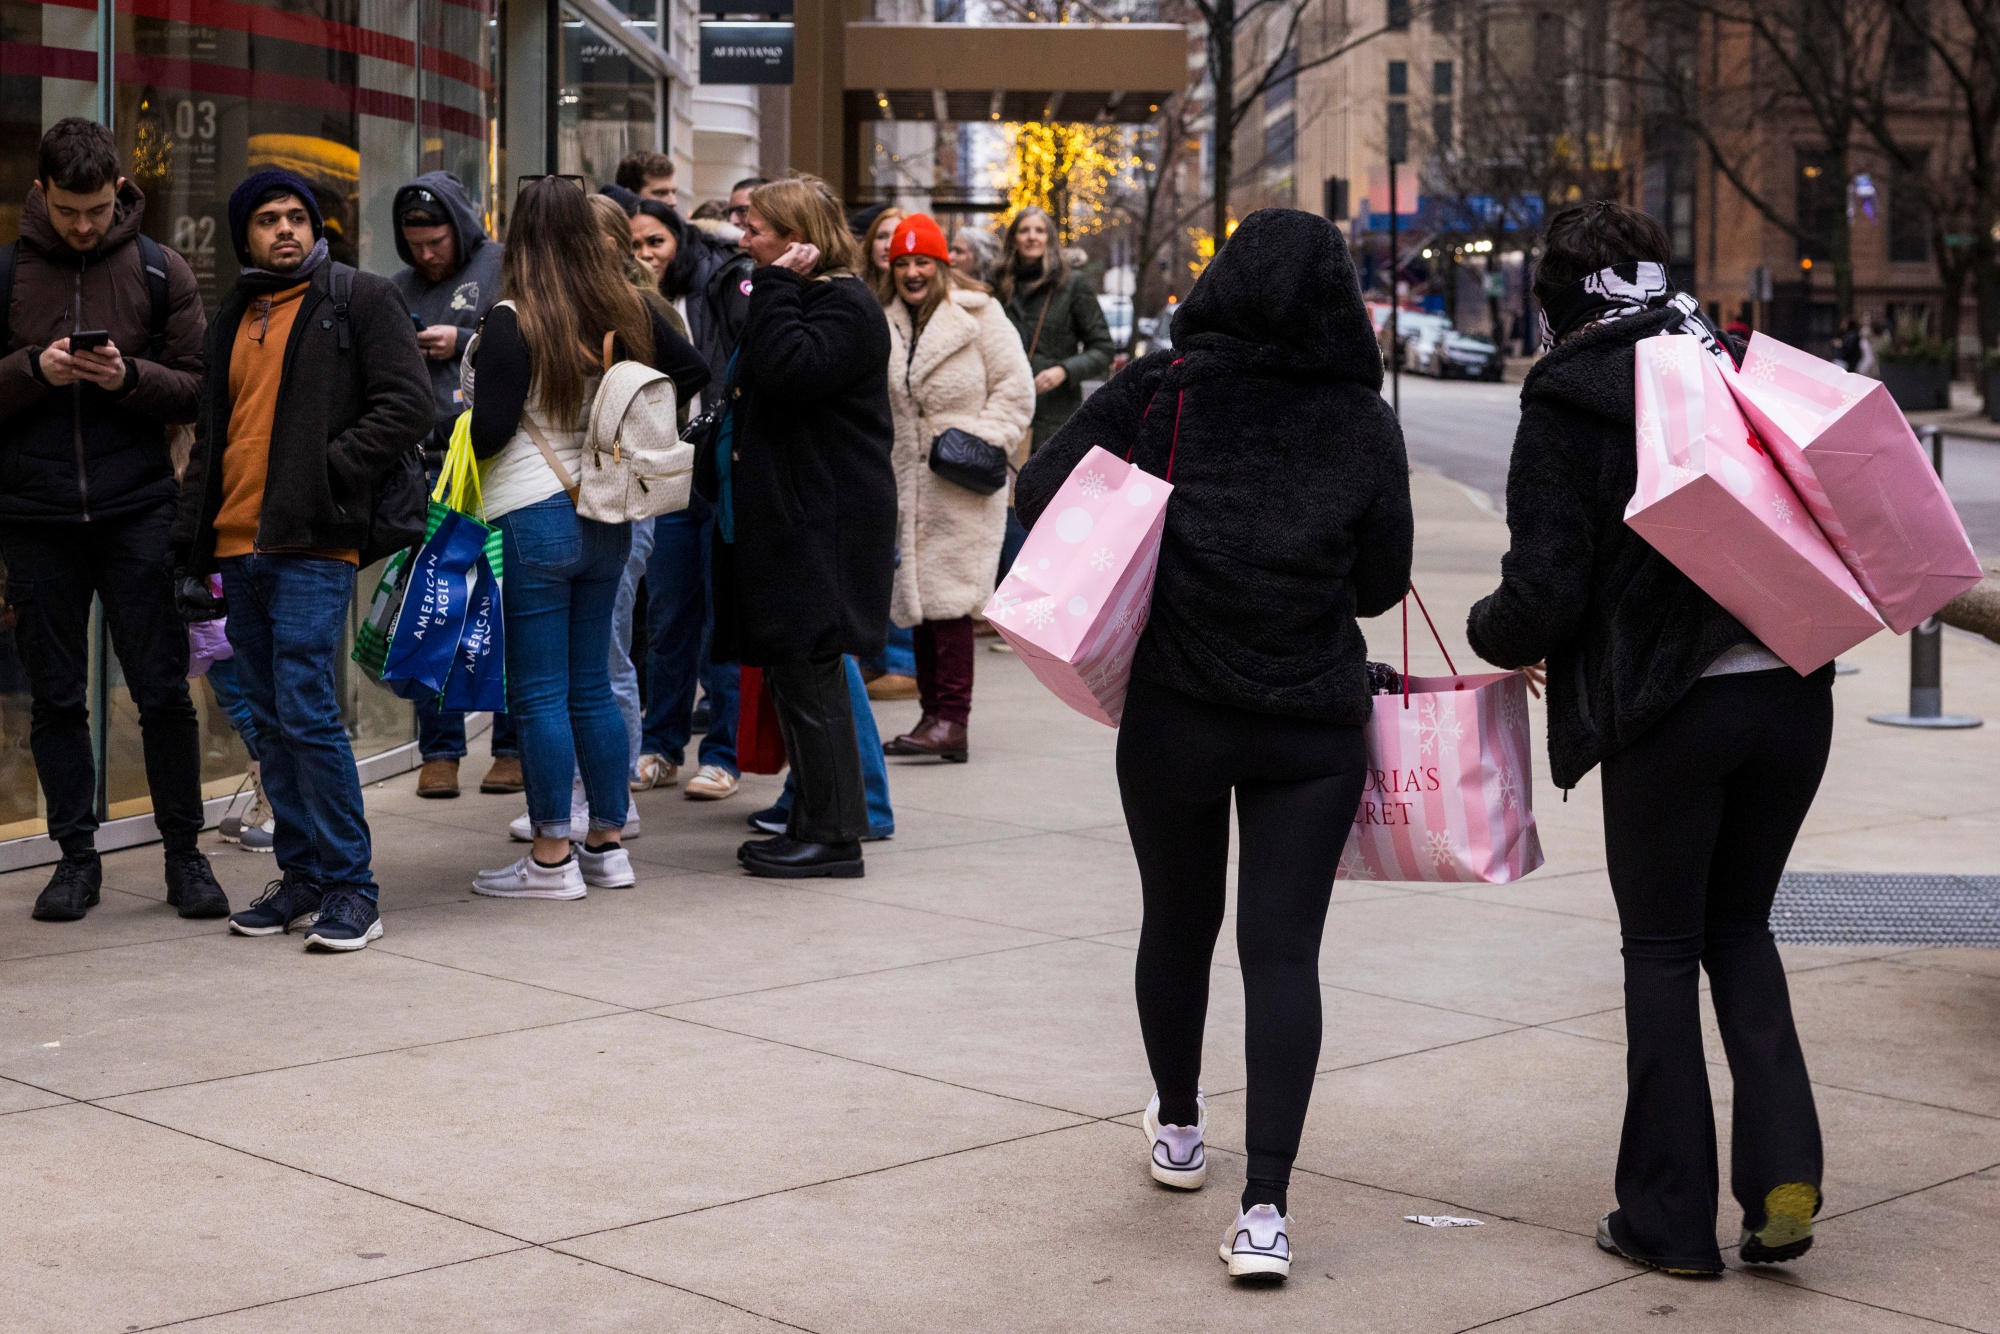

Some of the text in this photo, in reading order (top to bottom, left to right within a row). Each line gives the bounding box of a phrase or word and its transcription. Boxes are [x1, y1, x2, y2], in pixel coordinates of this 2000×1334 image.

[175, 100, 216, 139] 03
[174, 215, 216, 254] 02
[413, 554, 438, 640] AMERICAN
[434, 578, 449, 625] EAGLE
[465, 596, 491, 673] AMERICAN
[1363, 766, 1440, 793] ORIA'S
[1353, 801, 1413, 825] RET
